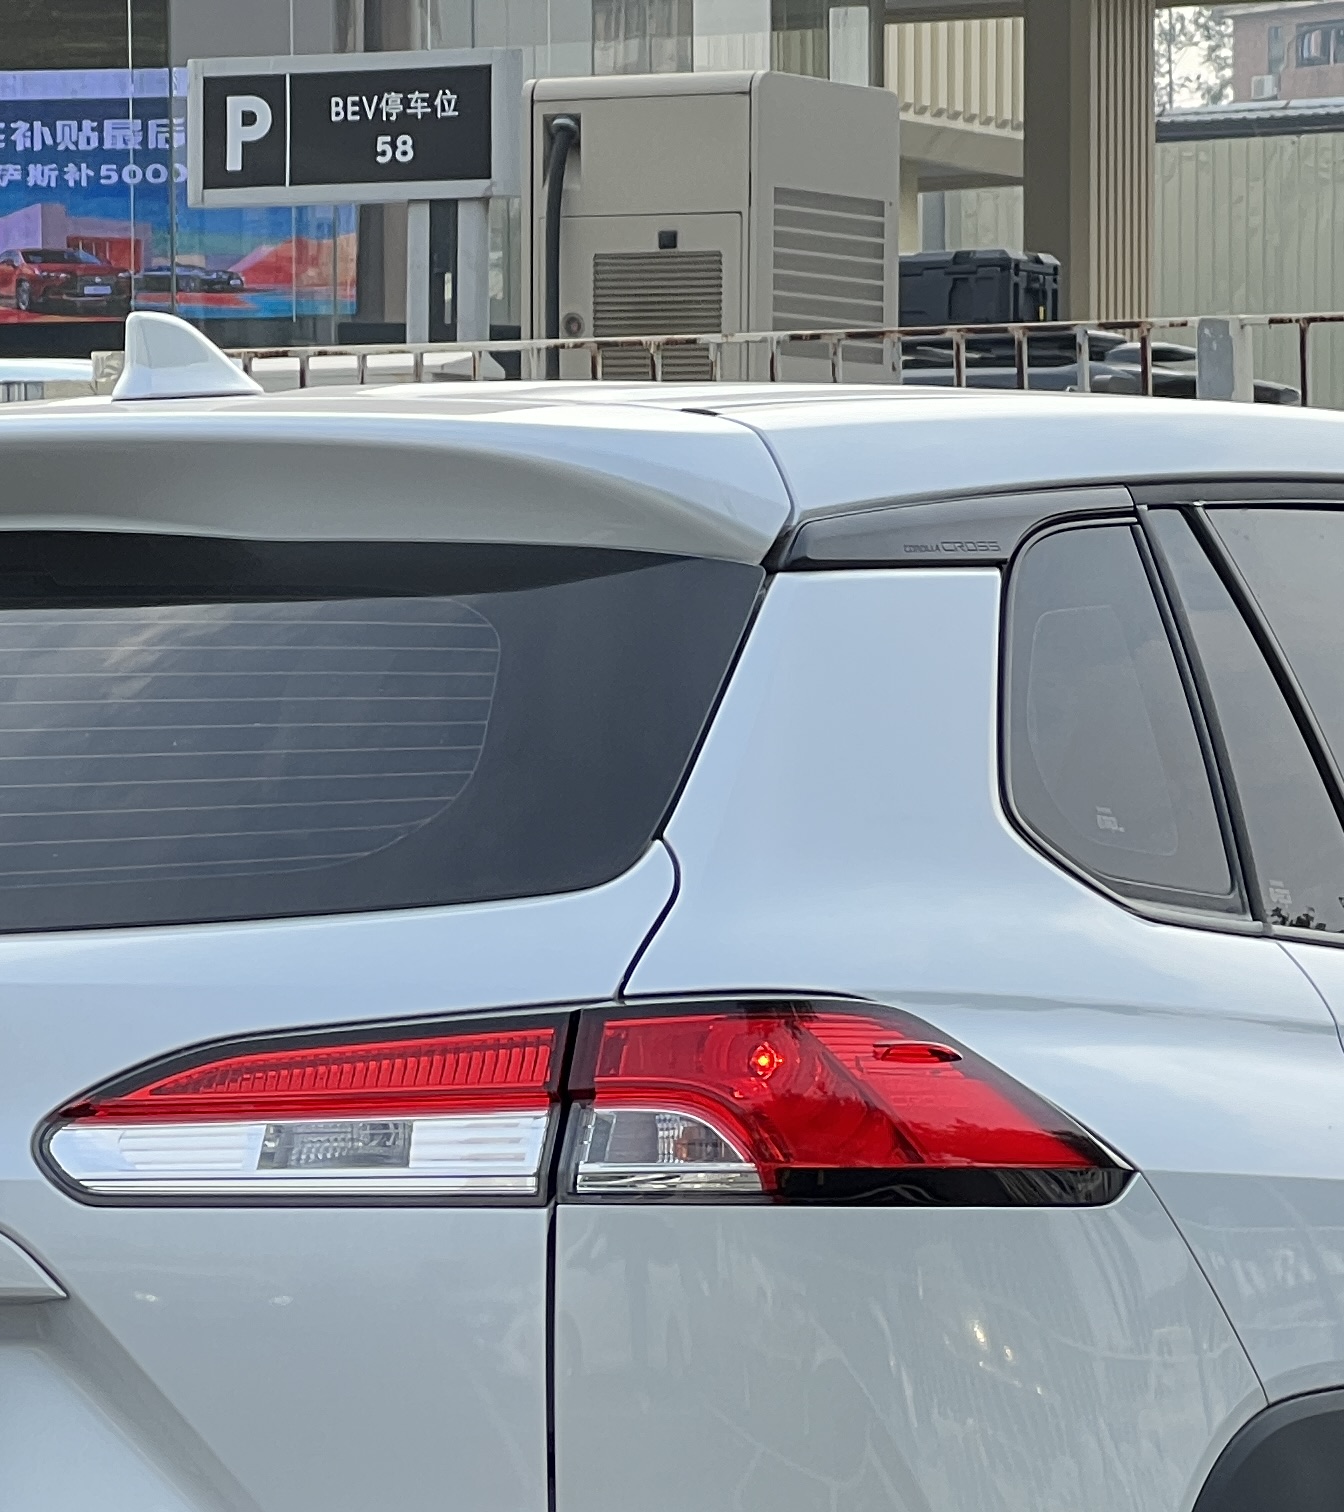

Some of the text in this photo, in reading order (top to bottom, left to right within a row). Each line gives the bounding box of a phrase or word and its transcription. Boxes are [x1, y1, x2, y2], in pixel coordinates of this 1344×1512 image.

[331, 90, 459, 122] BEV停车位
[226, 96, 272, 171] P
[376, 135, 414, 164] 58
[940, 541, 1001, 552] CROSS
